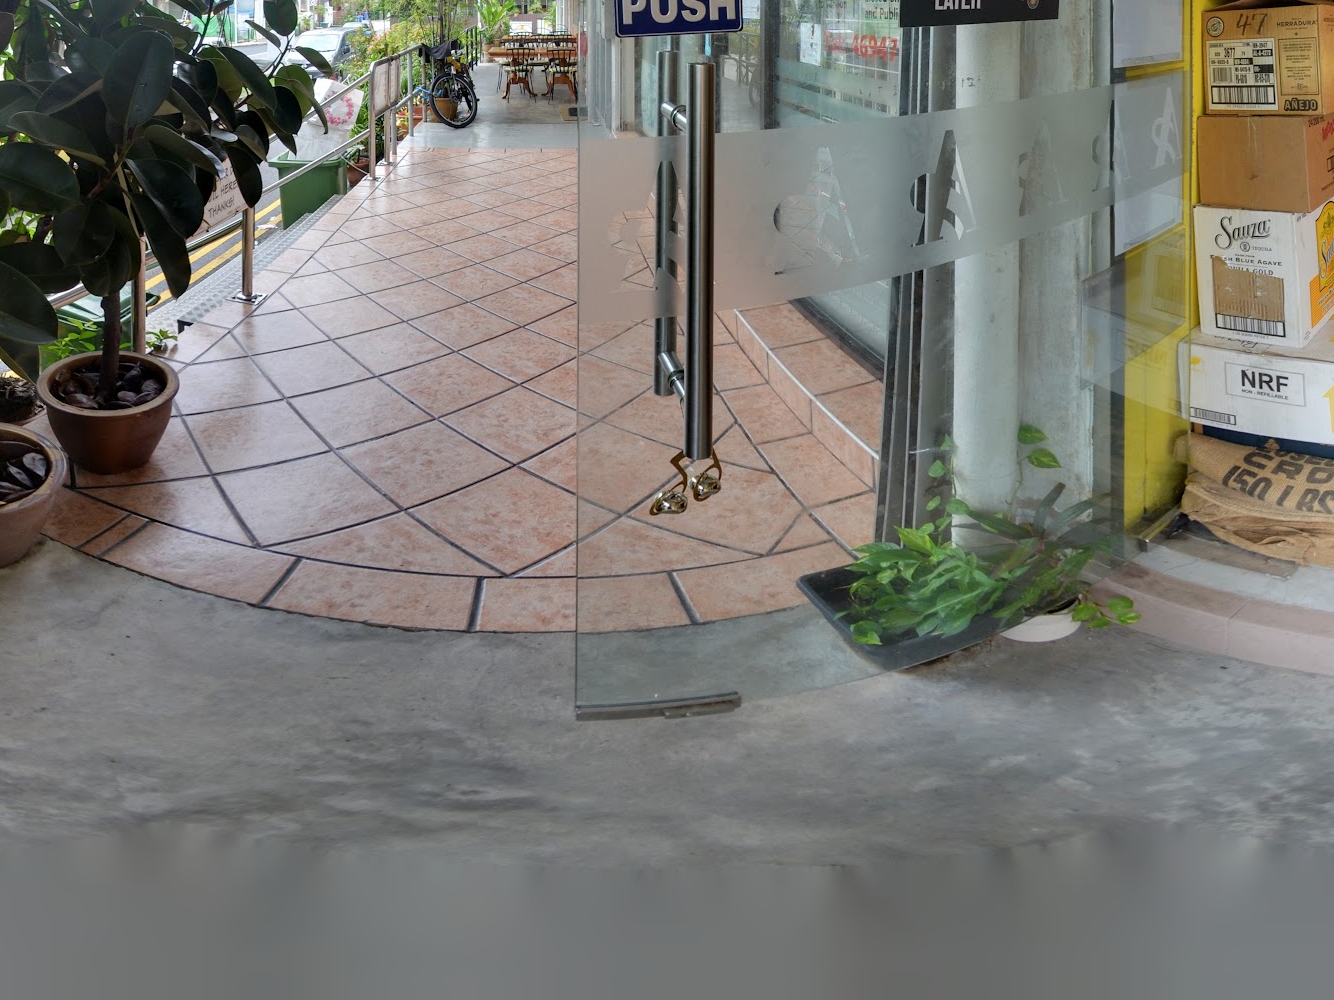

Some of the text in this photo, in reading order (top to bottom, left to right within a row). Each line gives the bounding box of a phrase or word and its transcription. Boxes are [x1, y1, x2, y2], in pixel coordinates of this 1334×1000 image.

[879, 6, 899, 21] Publi
[1236, 13, 1268, 36] 47
[1284, 98, 1318, 111] AÑEJO
[208, 195, 236, 219] THANKS!
[1214, 216, 1271, 250] Sauza
[1210, 254, 1283, 267] FSH BLUE AGAVE
[1252, 267, 1274, 276] GOLD
[1241, 369, 1289, 393] NRF
[1257, 391, 1289, 400] REFILLABLE
